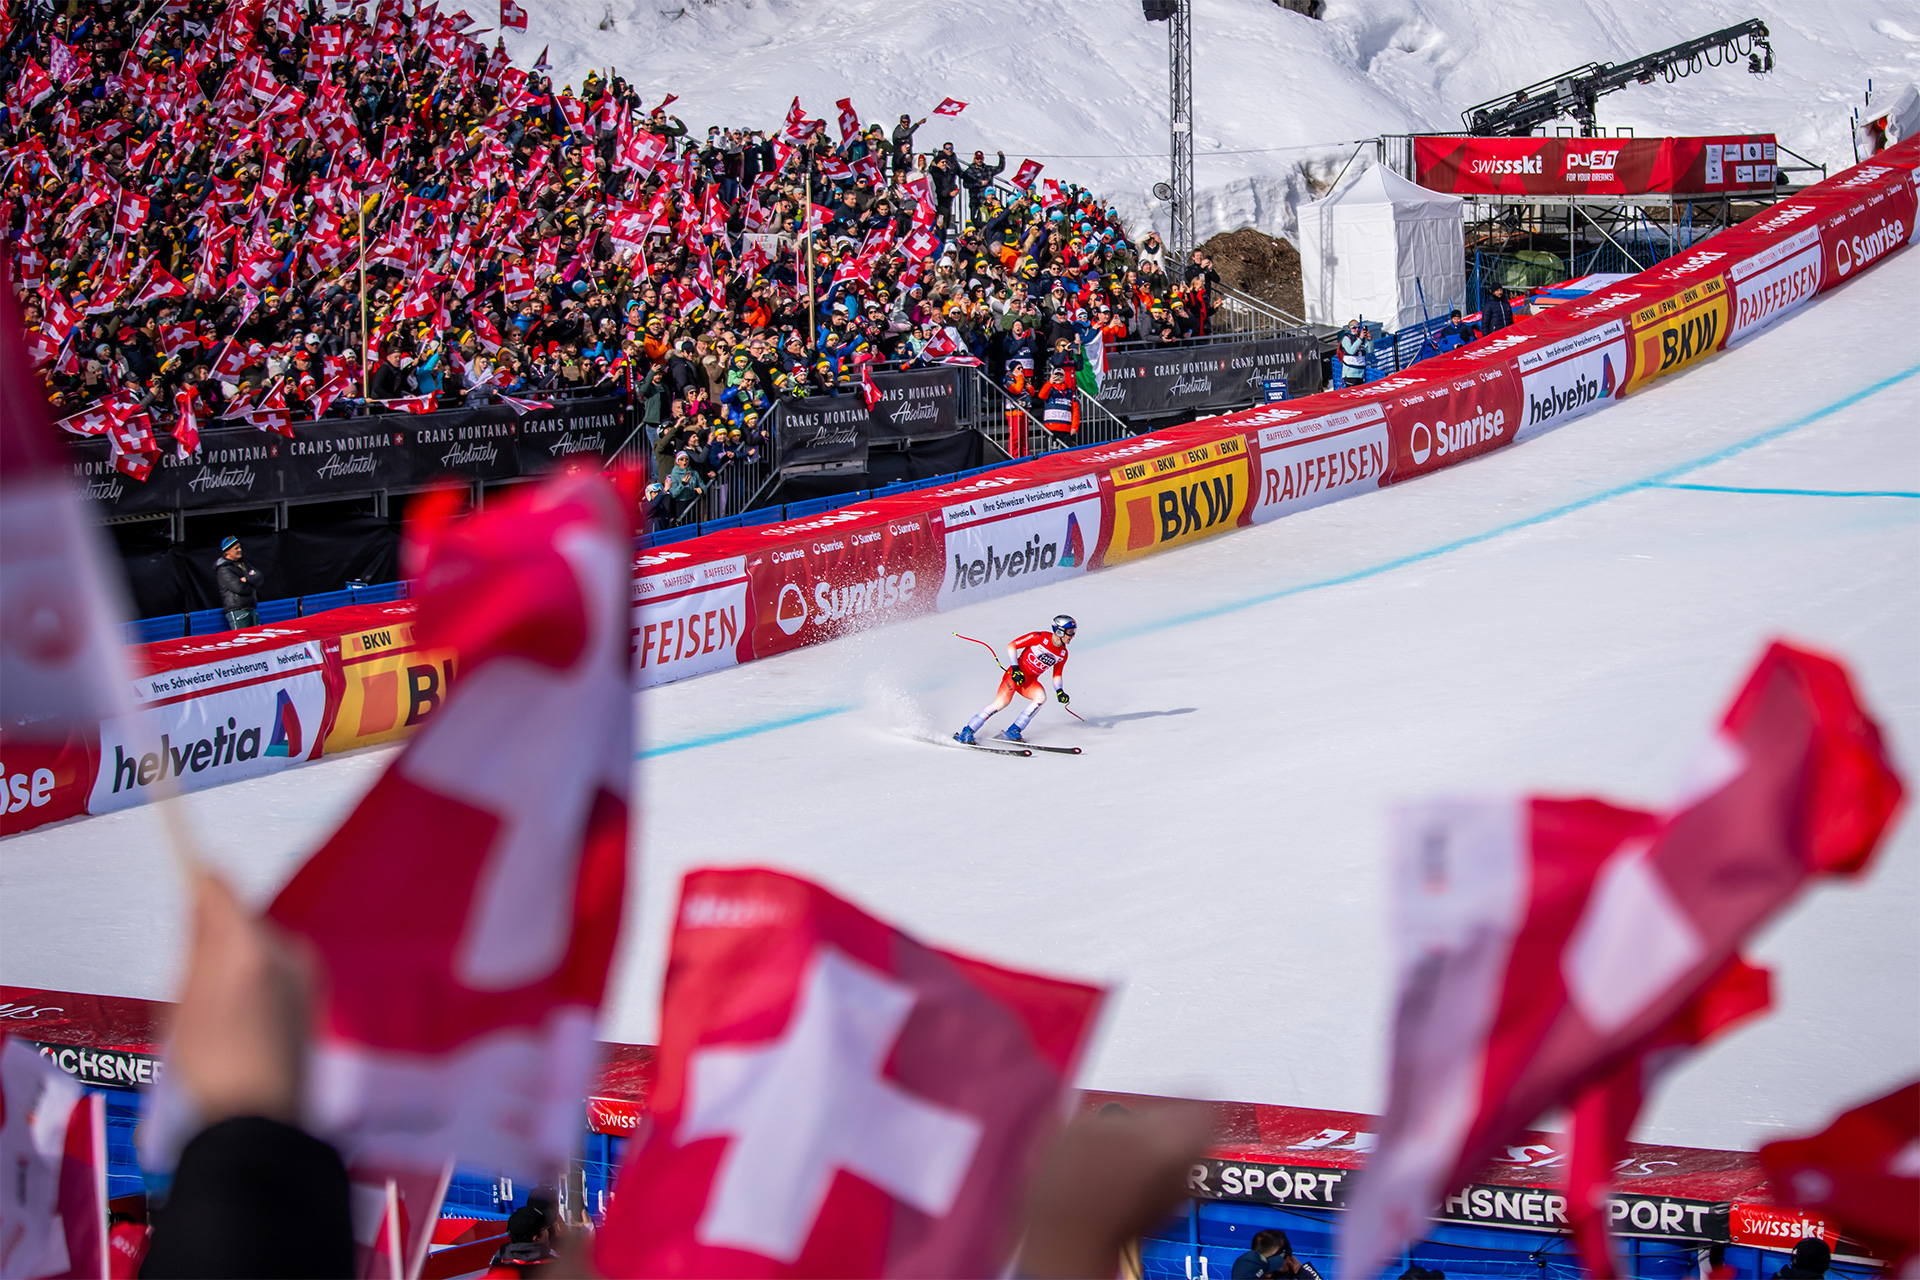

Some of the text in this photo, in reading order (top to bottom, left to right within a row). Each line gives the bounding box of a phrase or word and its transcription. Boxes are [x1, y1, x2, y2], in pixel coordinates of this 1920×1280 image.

[1470, 155, 1542, 174] swissski
[1566, 173, 1576, 181] FOR
[1577, 173, 1590, 181] YOUR
[1852, 218, 1904, 267] Sunrise
[1640, 279, 1721, 322] BKW BKW BKW BKW
[1738, 262, 1818, 330] RAIFFEISEN
[1660, 309, 1718, 372] BKW
[1102, 367, 1136, 381] NTANA
[1154, 360, 1219, 377] CRANS MONTANA
[1231, 356, 1254, 369] CRANS
[1257, 352, 1296, 366] MONTANA
[878, 384, 947, 401] ANS MONTANA
[1529, 373, 1598, 426] helvetia
[524, 413, 616, 434] CRANS MONTANA
[785, 408, 870, 428] CRANS MONTANA
[890, 400, 939, 424] Absolutely
[1266, 429, 1294, 442] RAIFFEISEN
[1354, 408, 1378, 421] RAIFFEISEN
[290, 433, 390, 456] CRANS MONTANA
[417, 423, 509, 444] CRANS MONTANA
[549, 431, 606, 456] Absolutely
[1435, 405, 1505, 457] Sunrise
[74, 461, 119, 477] MONT
[208, 445, 268, 464] MONTANA
[317, 452, 378, 479] Absolutely
[440, 442, 498, 467] Absolutely
[1125, 439, 1239, 480] BKW BKW BKW BKW
[188, 465, 256, 492] Absolutely
[1264, 441, 1384, 506] RAIFFEISEN
[949, 509, 970, 521] helvetia
[983, 502, 996, 513] Ihre
[996, 496, 1025, 512] Schweizer
[1025, 488, 1064, 504] Versicherung
[1068, 481, 1087, 493] helvetia
[1158, 474, 1233, 543] BKW
[779, 548, 805, 563] Sunrise
[820, 539, 844, 553] Sunrise
[858, 530, 882, 544] Sunrise
[897, 521, 920, 535] Sunrise
[952, 533, 1057, 593] helvetia
[633, 564, 737, 594] FEISEN RAIFFEISEN RAIFFEISEN
[814, 565, 916, 625] Sunrise
[361, 630, 392, 650] BKW
[631, 605, 738, 669] FFEISEN
[151, 652, 305, 694] Ihre Schweizer Versicherung helvetia
[112, 716, 261, 794] helvetia
[1221, 1166, 1342, 1202] SPORT
[1445, 1187, 1710, 1234] HSNER PORT
[1743, 1214, 1825, 1241] swissski
